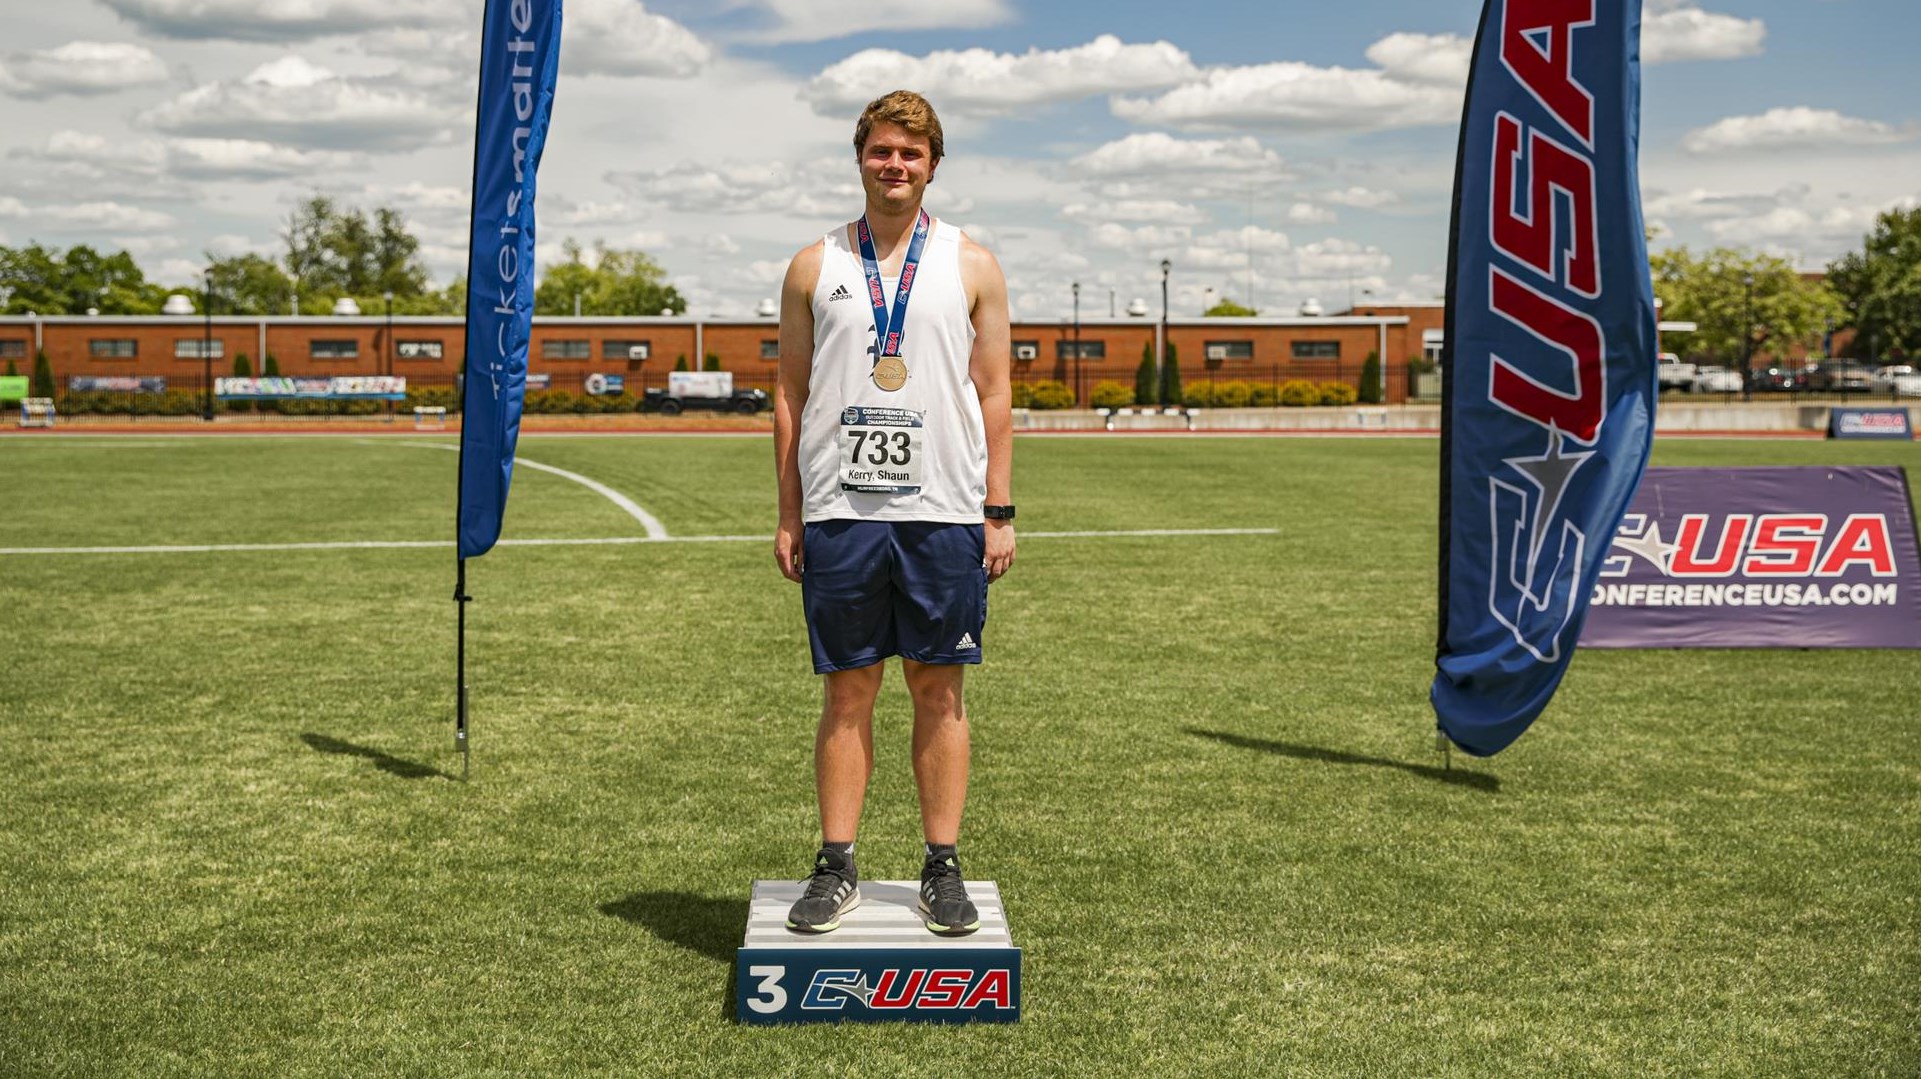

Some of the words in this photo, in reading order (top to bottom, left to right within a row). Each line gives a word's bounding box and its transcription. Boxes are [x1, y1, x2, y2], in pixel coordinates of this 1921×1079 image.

[829, 293, 853, 302] adidas
[862, 408, 904, 417] CONFERENCE
[904, 410, 919, 418] USA
[848, 430, 911, 466] 733
[848, 469, 875, 482] Kerry,
[877, 470, 910, 481] Shaun
[1589, 583, 1898, 606] ONFERENCEUSA.COM
[746, 965, 788, 1014] 3
